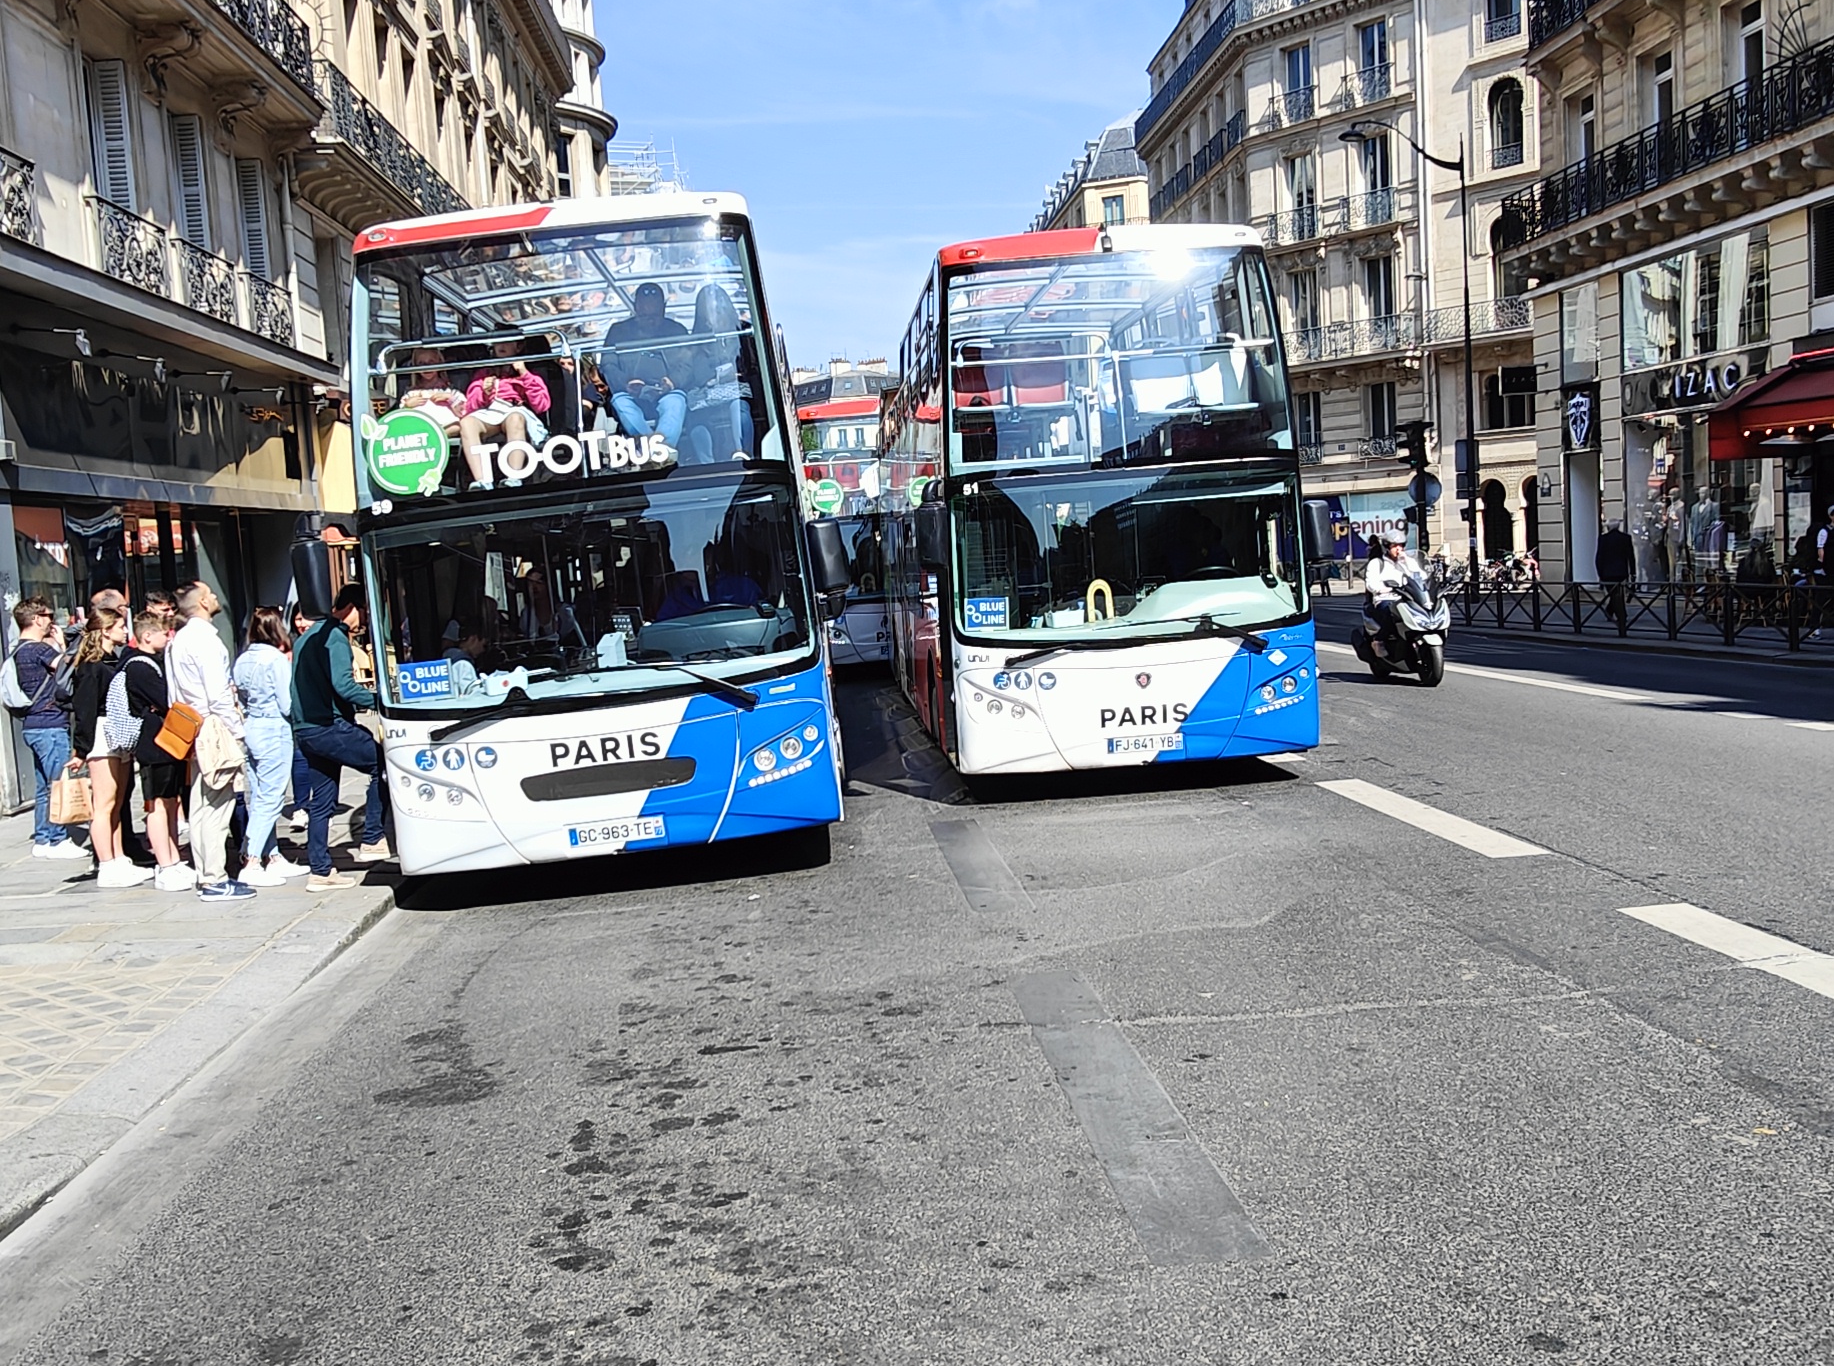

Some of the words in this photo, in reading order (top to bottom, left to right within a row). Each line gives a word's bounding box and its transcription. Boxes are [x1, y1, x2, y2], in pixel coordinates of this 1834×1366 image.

[1674, 364, 1737, 398] IZAC
[382, 432, 429, 451] PLANET
[378, 448, 436, 468] FRIENDLY
[962, 482, 979, 495] 51
[371, 499, 393, 516] 59
[1331, 515, 1408, 540] pening
[979, 602, 1005, 612] BLUE
[982, 614, 1005, 624] LINE
[415, 664, 449, 679] BLUE
[421, 680, 450, 694] LINE
[1100, 702, 1189, 728] PARIS
[549, 731, 661, 768] PARIS
[578, 821, 653, 843] GC-963-TE
